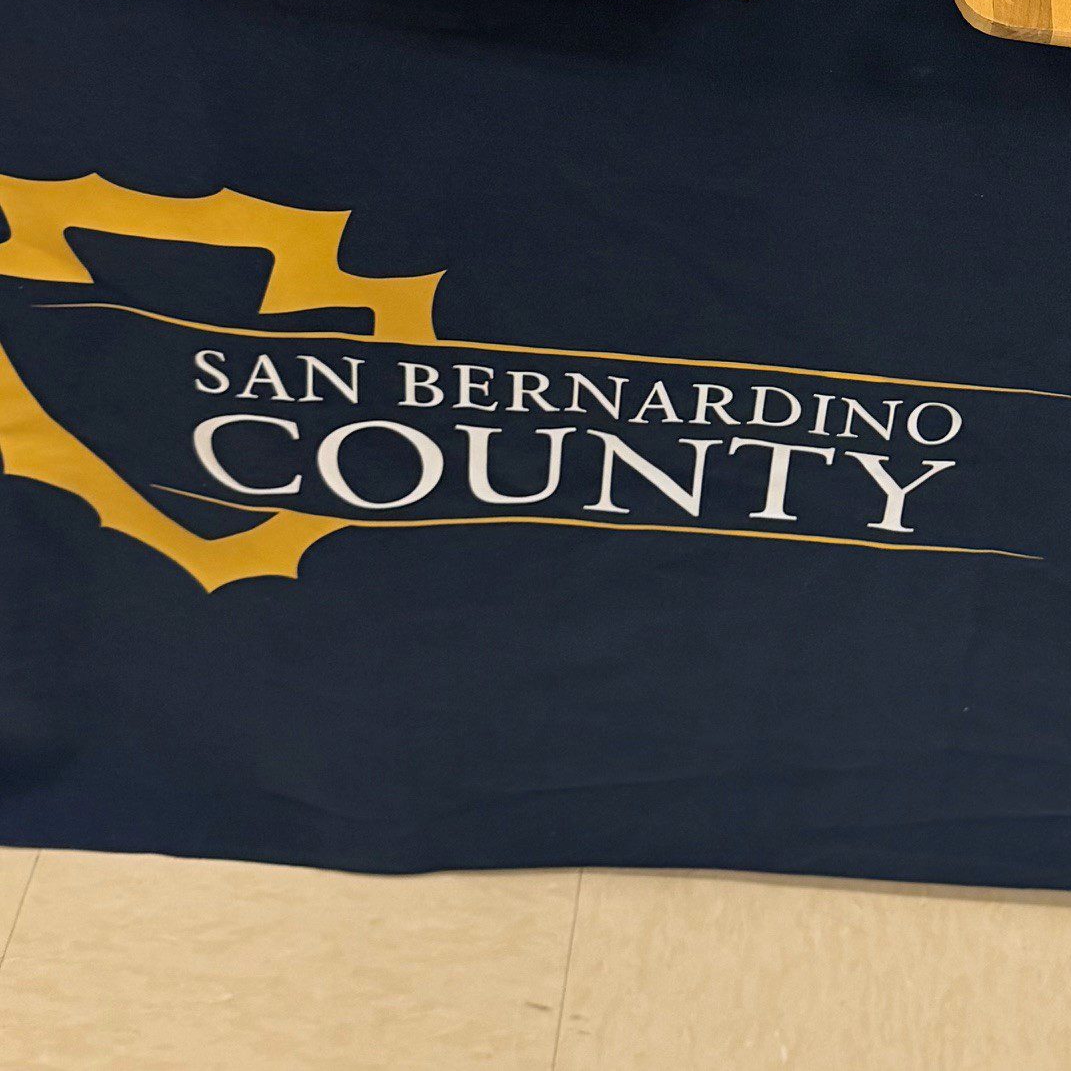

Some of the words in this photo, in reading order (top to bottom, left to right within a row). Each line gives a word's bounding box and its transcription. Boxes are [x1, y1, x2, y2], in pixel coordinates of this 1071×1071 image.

[193, 348, 366, 407] SAN
[397, 360, 963, 448] BERNARDINO
[191, 412, 957, 533] COUNTY
